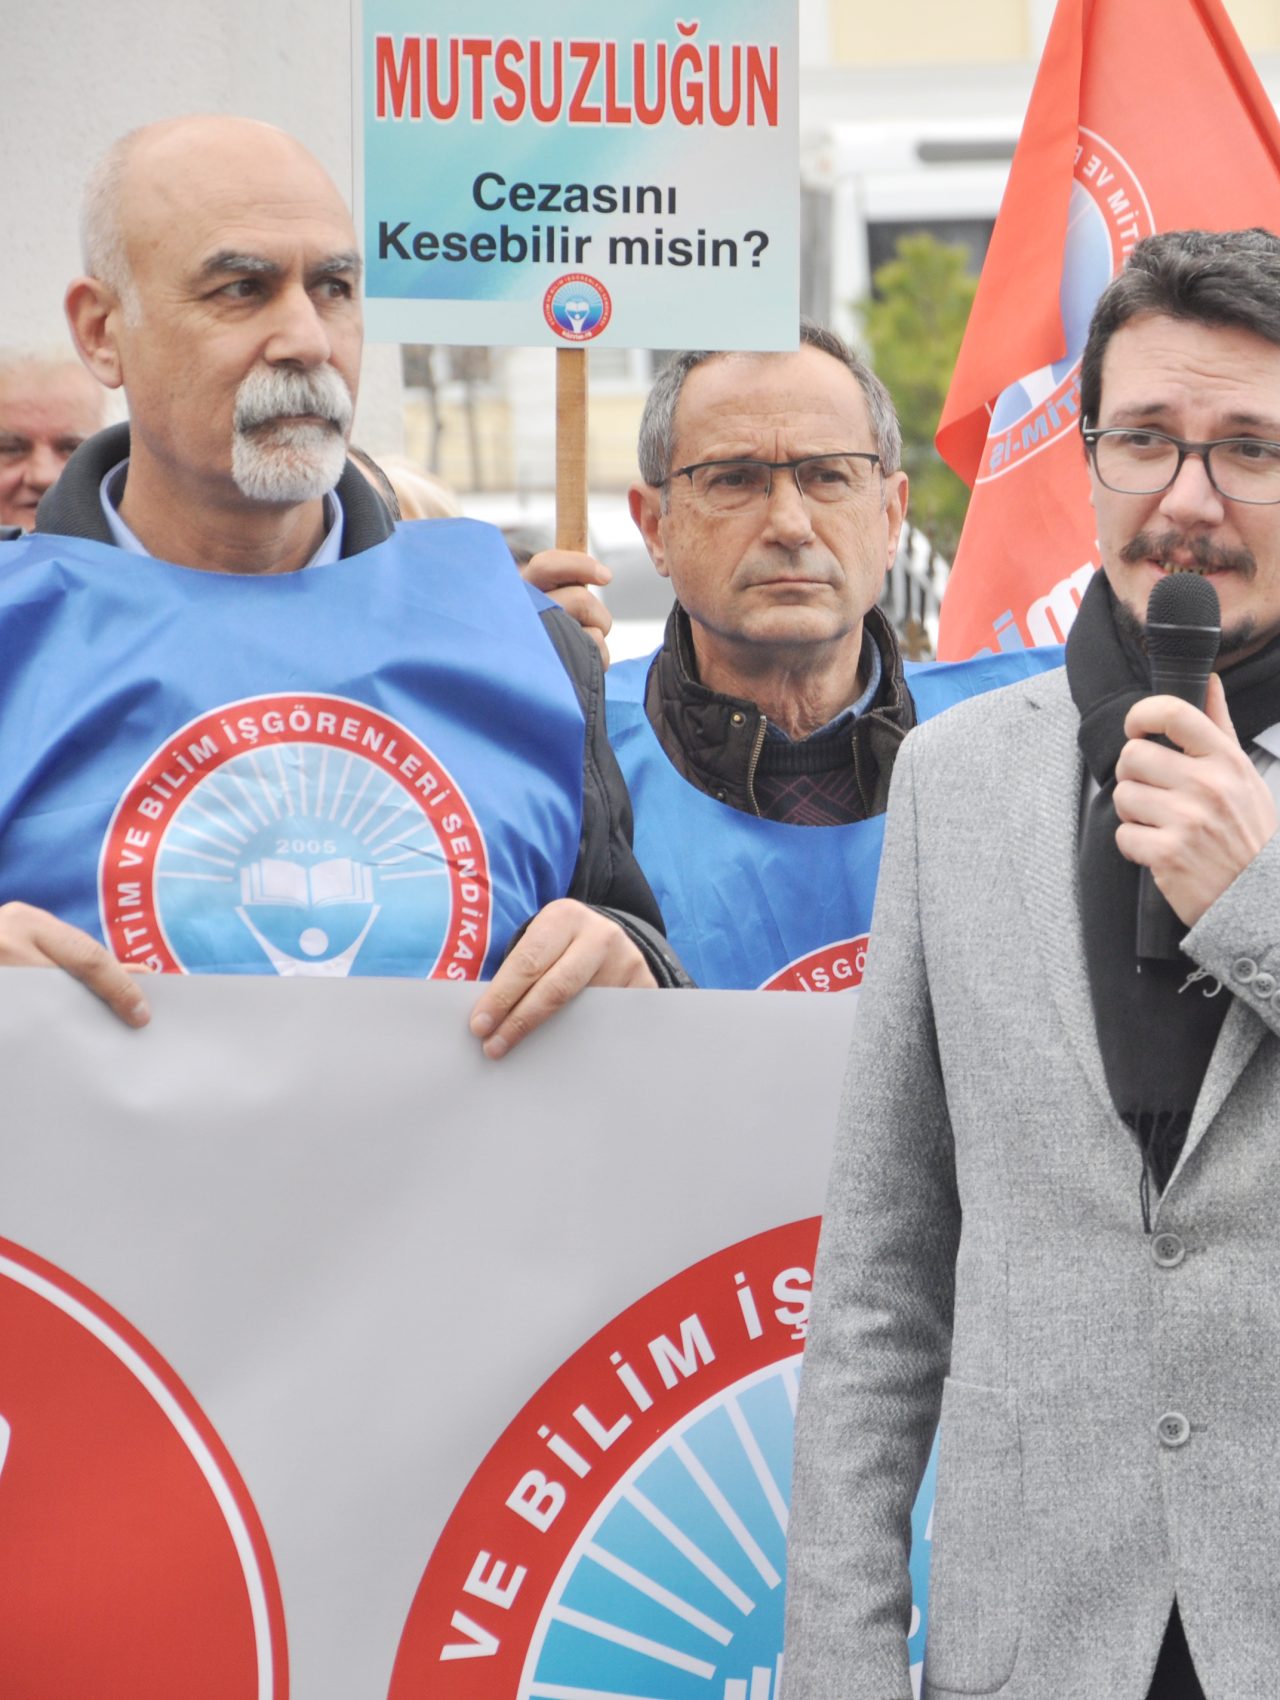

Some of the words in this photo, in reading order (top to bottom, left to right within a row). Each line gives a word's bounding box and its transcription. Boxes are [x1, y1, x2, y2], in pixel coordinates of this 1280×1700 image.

[375, 22, 779, 127] MUTSUZLUĞUN
[472, 172, 677, 215] Cezasını
[377, 221, 592, 264] Kesebilir
[608, 229, 770, 268] misin?
[117, 827, 151, 869] VE
[139, 735, 220, 820] BİLİM
[223, 704, 452, 808] İŞGÖRENLERİ
[441, 813, 483, 981] SENDİKAS
[275, 838, 337, 855] 2005
[796, 945, 868, 992] İŞGÖ
[439, 1550, 529, 1662] VE
[505, 1313, 717, 1534] BİLİM
